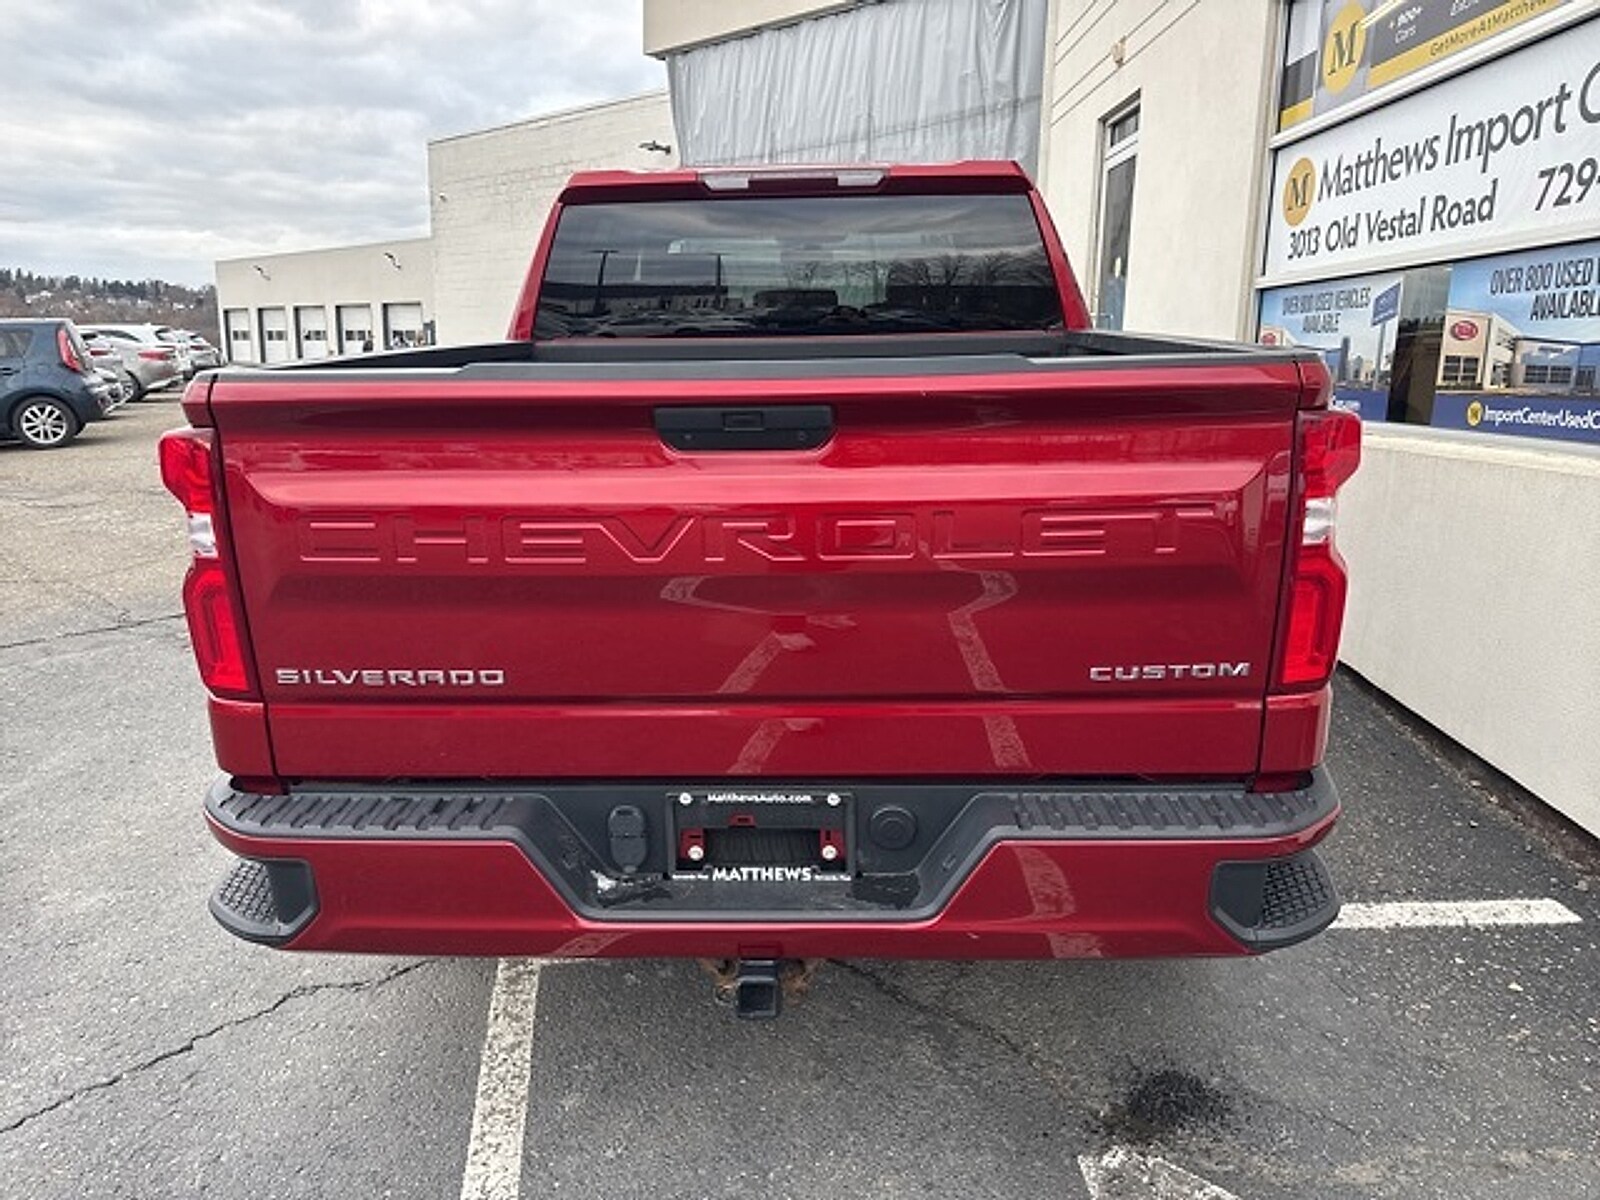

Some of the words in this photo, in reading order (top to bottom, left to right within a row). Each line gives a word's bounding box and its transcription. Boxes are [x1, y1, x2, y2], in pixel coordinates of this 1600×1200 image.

[1327, 20, 1360, 75] M
[1317, 131, 1441, 202] Matthews
[1444, 83, 1573, 174] Import
[1286, 173, 1310, 211] M
[1288, 225, 1321, 261] 3013
[1326, 213, 1361, 251] Old
[1366, 197, 1426, 243] Vestal
[1430, 178, 1498, 232] Road
[1490, 267, 1523, 295] OVER
[1525, 264, 1554, 292] 800
[1555, 258, 1593, 289] USED
[1530, 288, 1600, 321] AVAILABL
[299, 503, 1214, 564] CHEVROLET
[276, 668, 505, 687] SILVERADO
[1089, 661, 1251, 682] CUSTOM
[707, 792, 813, 804] MatthewsAuto.com
[712, 867, 812, 882] MATTHEWS
